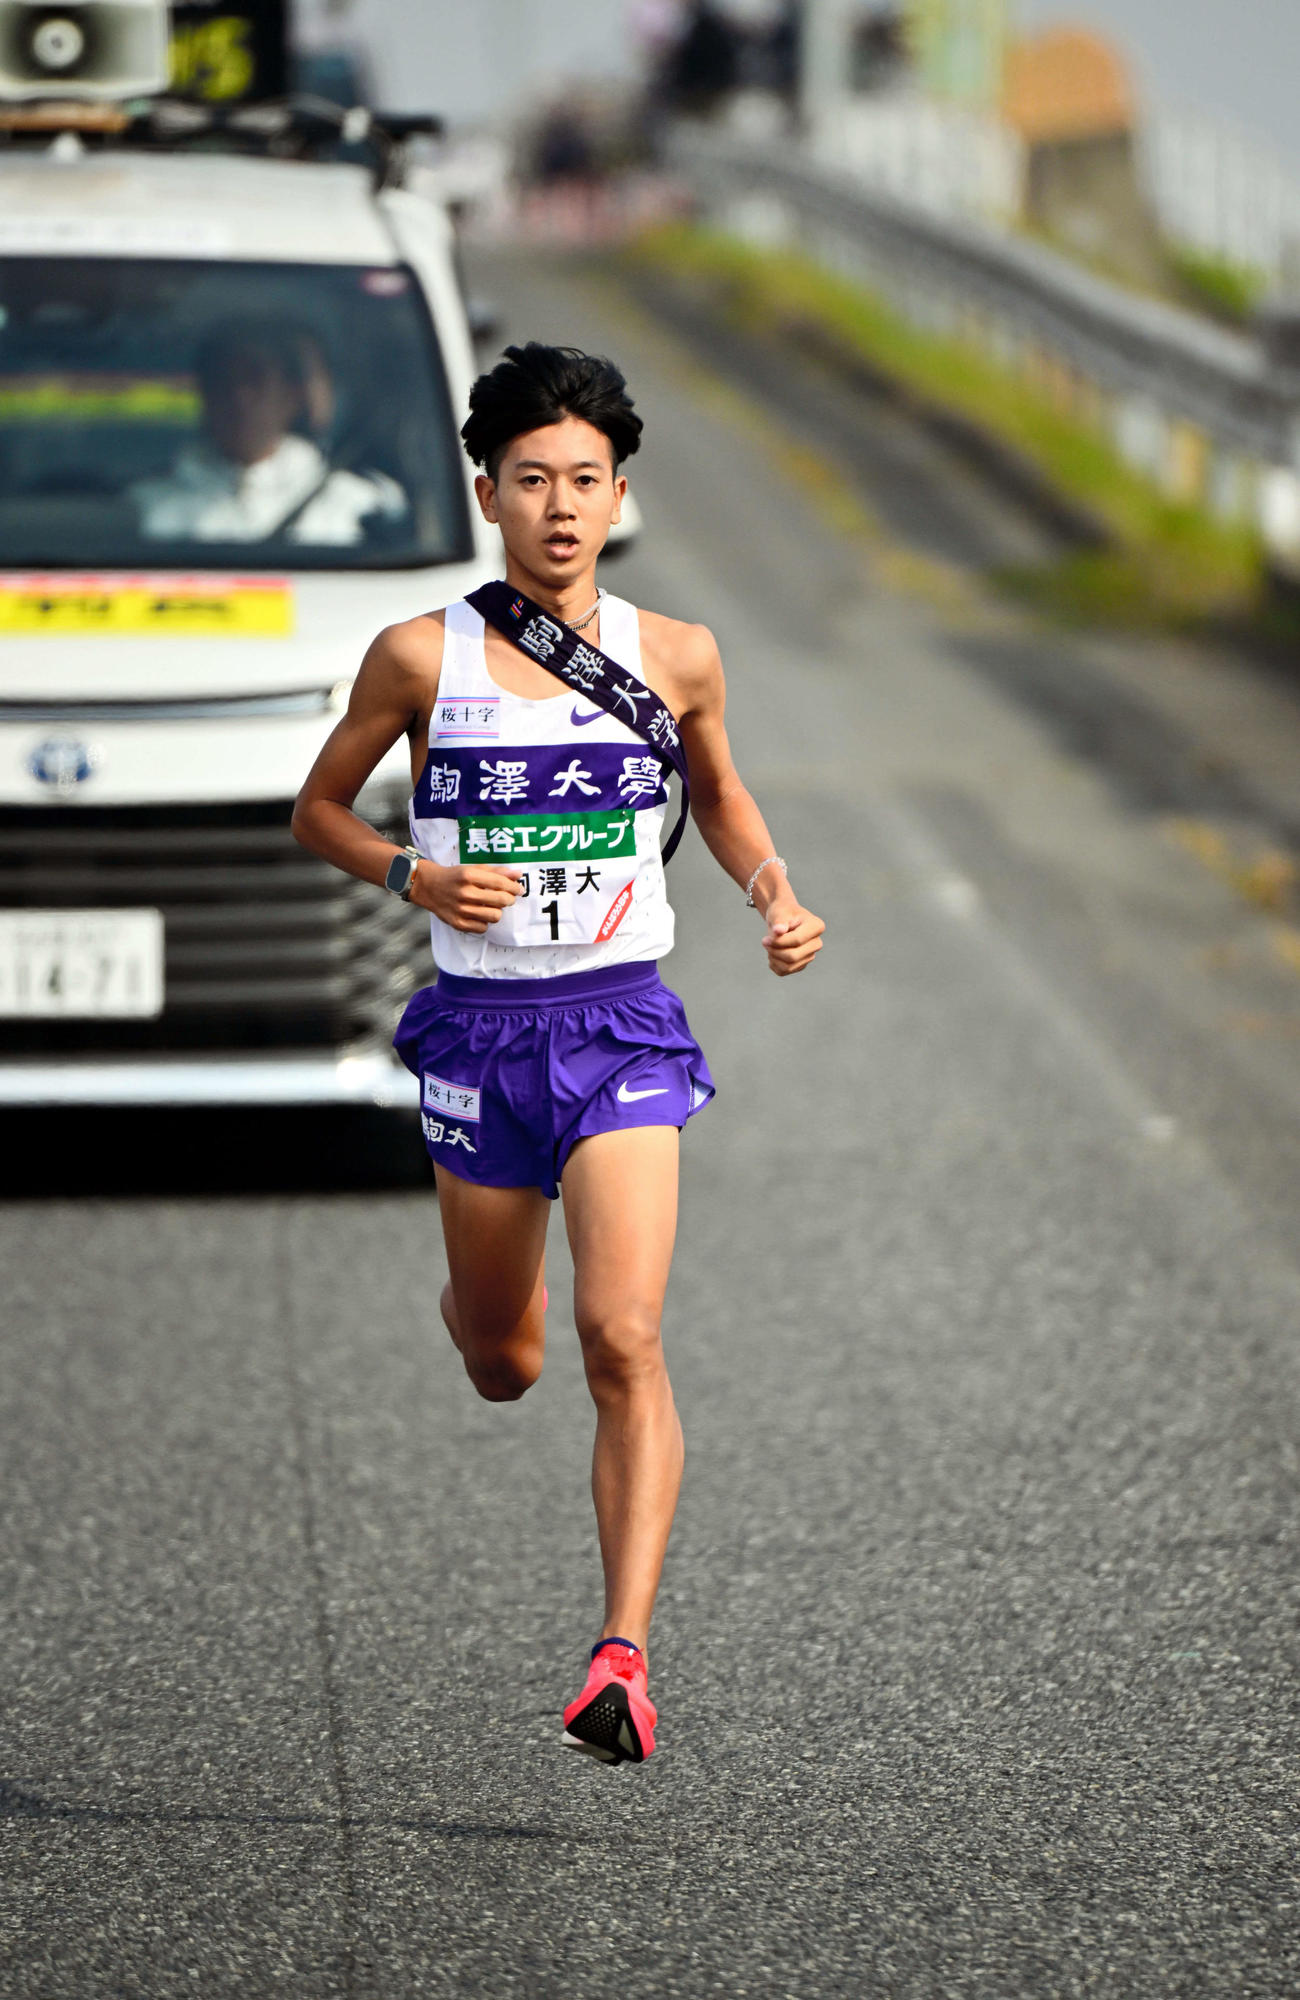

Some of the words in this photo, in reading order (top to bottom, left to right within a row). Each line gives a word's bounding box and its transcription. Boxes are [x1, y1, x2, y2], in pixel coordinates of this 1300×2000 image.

[517, 614, 680, 749] 駒澤大学
[441, 706, 495, 722] 桜十字
[466, 819, 631, 854] 長谷工グループ
[541, 900, 560, 941] 1
[428, 1082, 475, 1108] 桜十字
